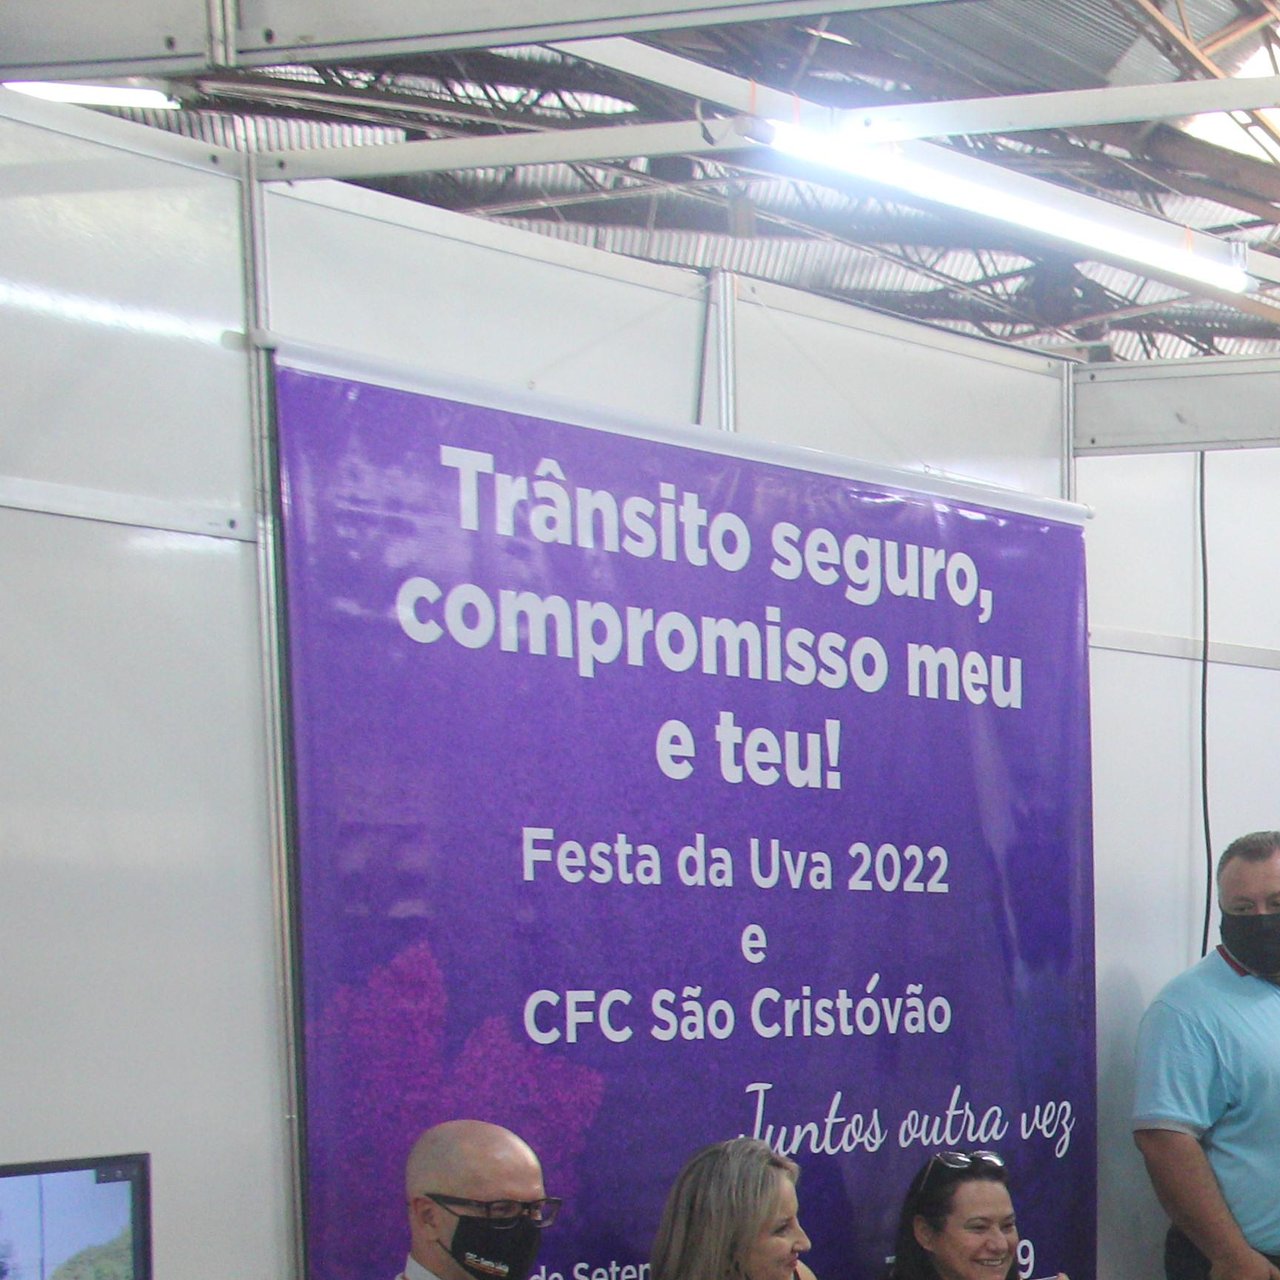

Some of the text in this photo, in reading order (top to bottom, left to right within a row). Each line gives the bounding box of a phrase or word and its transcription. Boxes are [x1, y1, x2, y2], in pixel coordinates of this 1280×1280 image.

[440, 445, 993, 624] Trânsito seguro,
[396, 576, 1022, 709] compromisso meu
[655, 711, 841, 790] e teu!
[522, 826, 949, 893] Festa da Uva 2022
[741, 924, 767, 964] e
[523, 972, 952, 1045] CFC São Cristóvão
[738, 1082, 1076, 1159] Juntos outra vez
